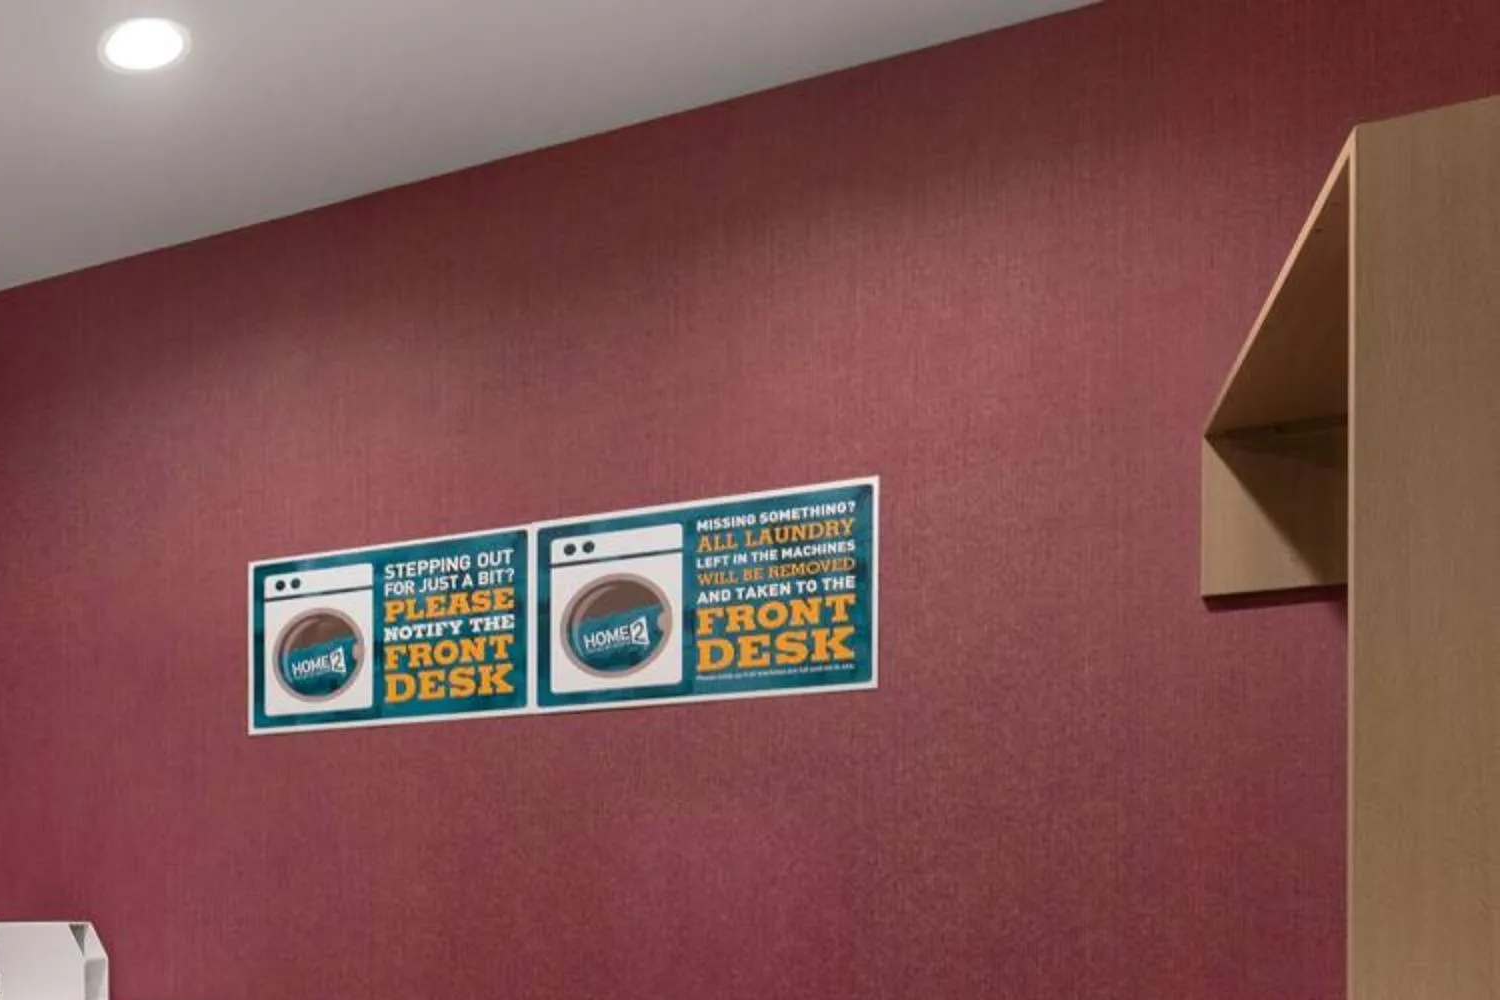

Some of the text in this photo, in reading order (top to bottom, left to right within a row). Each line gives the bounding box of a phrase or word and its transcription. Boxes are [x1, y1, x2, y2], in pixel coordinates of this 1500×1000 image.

[696, 501, 855, 531] MISSING SOMETHING?
[697, 518, 855, 553] ALL LAUNDRY
[384, 549, 514, 580] STEPPING OUT
[697, 540, 855, 569] LEFT IN THE MACHINES
[384, 568, 514, 597] FOR JUST A BIT?
[697, 557, 855, 587] WILL BE REMOVED
[384, 587, 514, 624] PLEASE
[697, 576, 856, 605] AND TAKEN TO THE
[384, 614, 515, 642] NOTIFY THE
[696, 594, 856, 635] FRONT
[384, 634, 514, 671] FRONT
[696, 626, 855, 673] DESK
[384, 664, 514, 705] DESK
